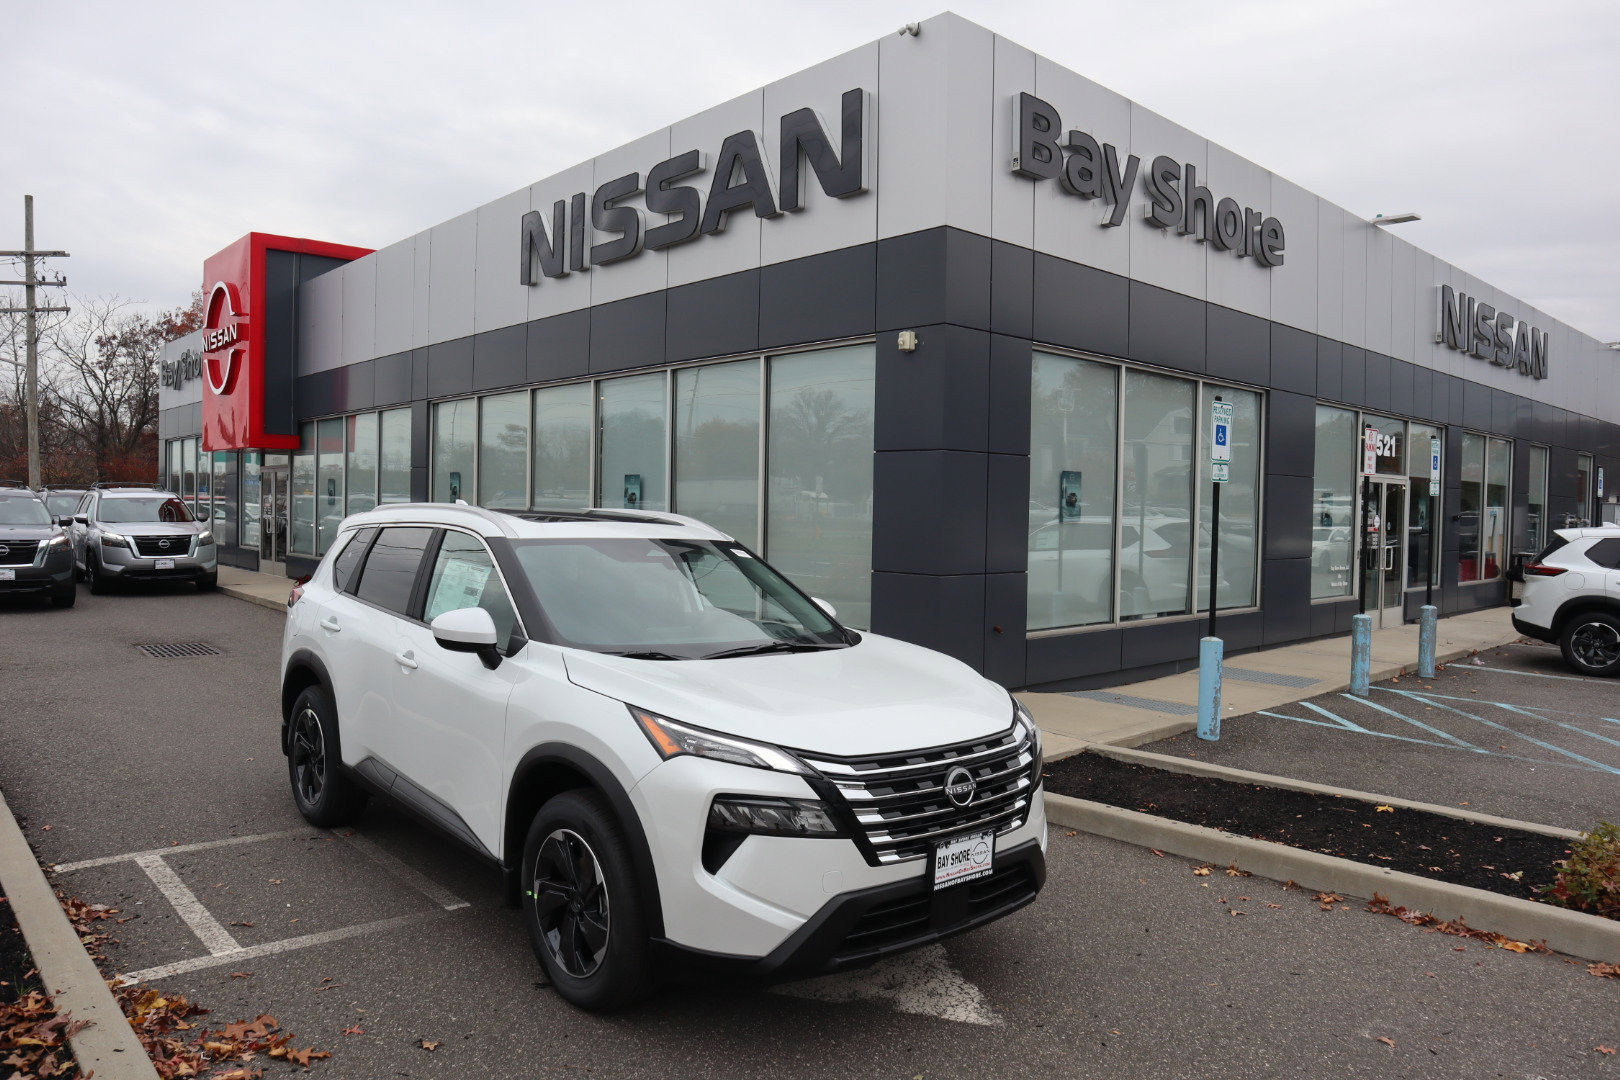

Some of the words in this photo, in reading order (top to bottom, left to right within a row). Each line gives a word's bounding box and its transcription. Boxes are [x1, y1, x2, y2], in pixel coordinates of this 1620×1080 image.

[520, 88, 866, 286] NISSAN
[1015, 92, 1140, 226] Bay
[1146, 155, 1285, 266] Shore
[203, 323, 237, 352] NISSAN
[1441, 284, 1548, 380] NISSAN
[161, 360, 181, 390] Bay
[181, 349, 204, 380] Sho
[946, 782, 976, 795] NISSAN
[938, 855, 950, 869] BAY
[951, 849, 970, 866] SHORE
[934, 868, 993, 891] NISSANOFBAYSHORE.COM
